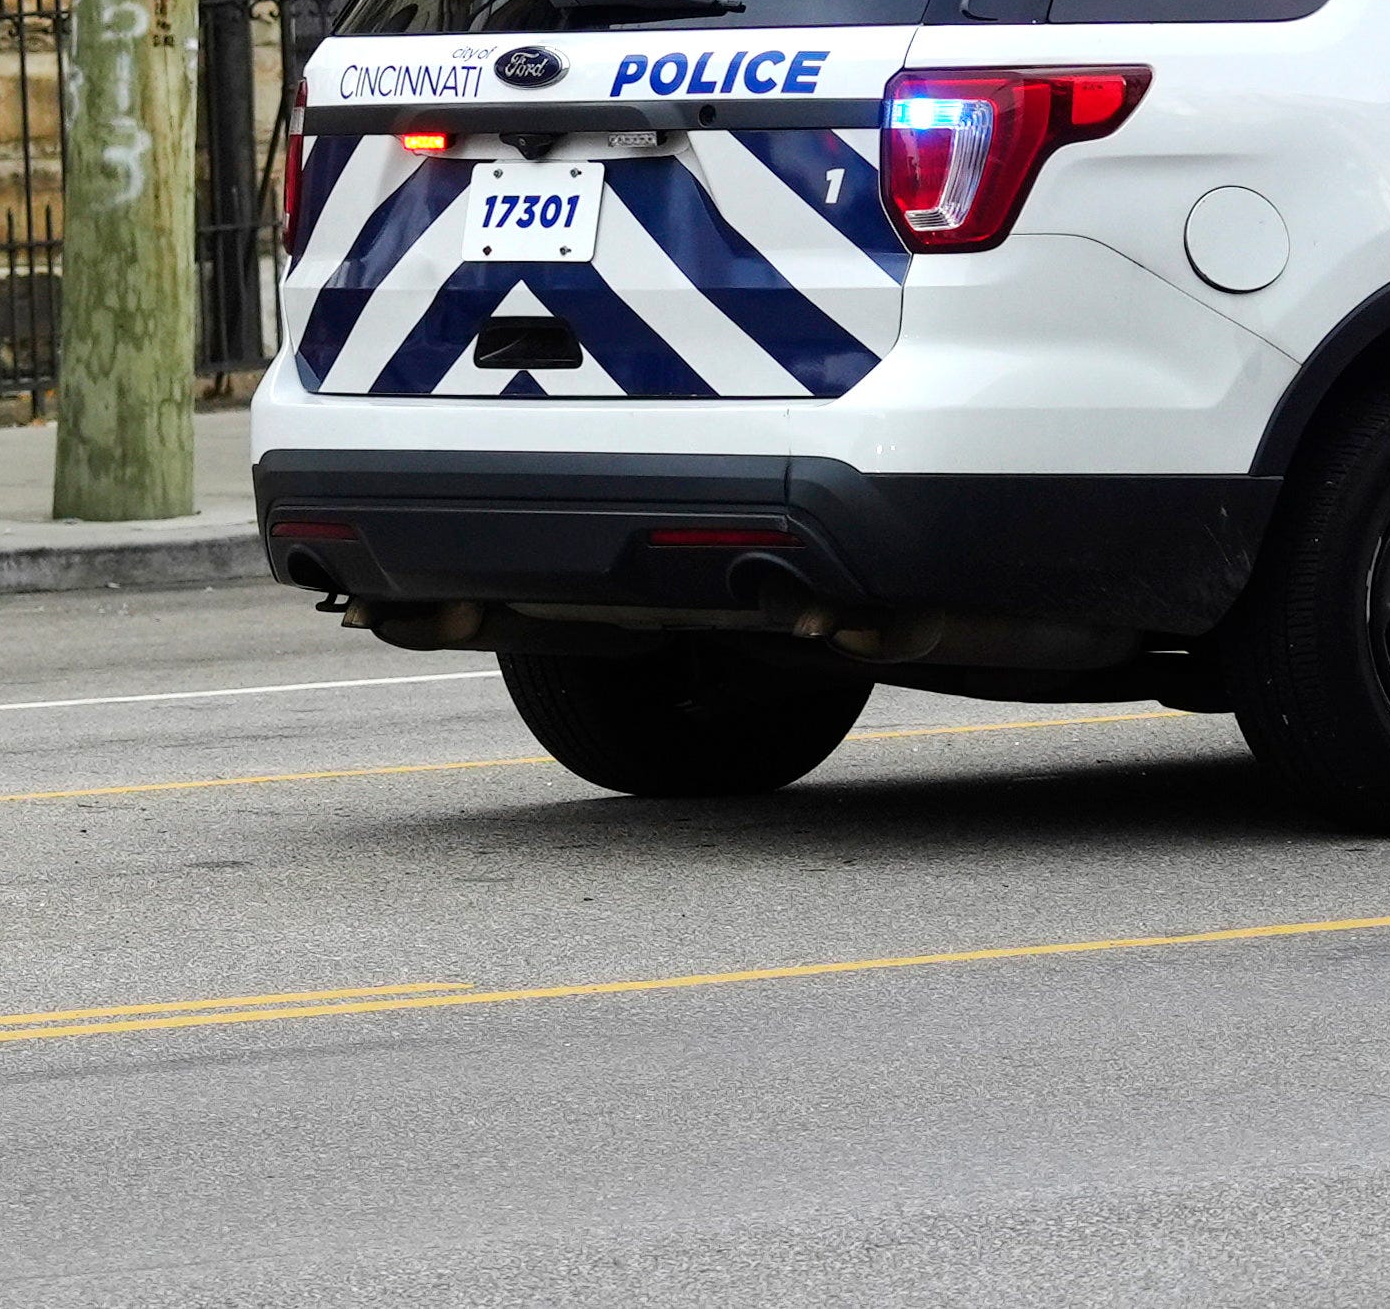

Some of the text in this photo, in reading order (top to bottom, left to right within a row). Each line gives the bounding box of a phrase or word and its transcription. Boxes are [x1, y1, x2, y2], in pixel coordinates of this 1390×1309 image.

[452, 45, 498, 62] city of
[504, 51, 549, 78] Ford
[339, 64, 483, 100] CINCINNATI
[609, 50, 831, 98] POLICE
[824, 168, 846, 204] 1
[481, 194, 581, 229] 17301
